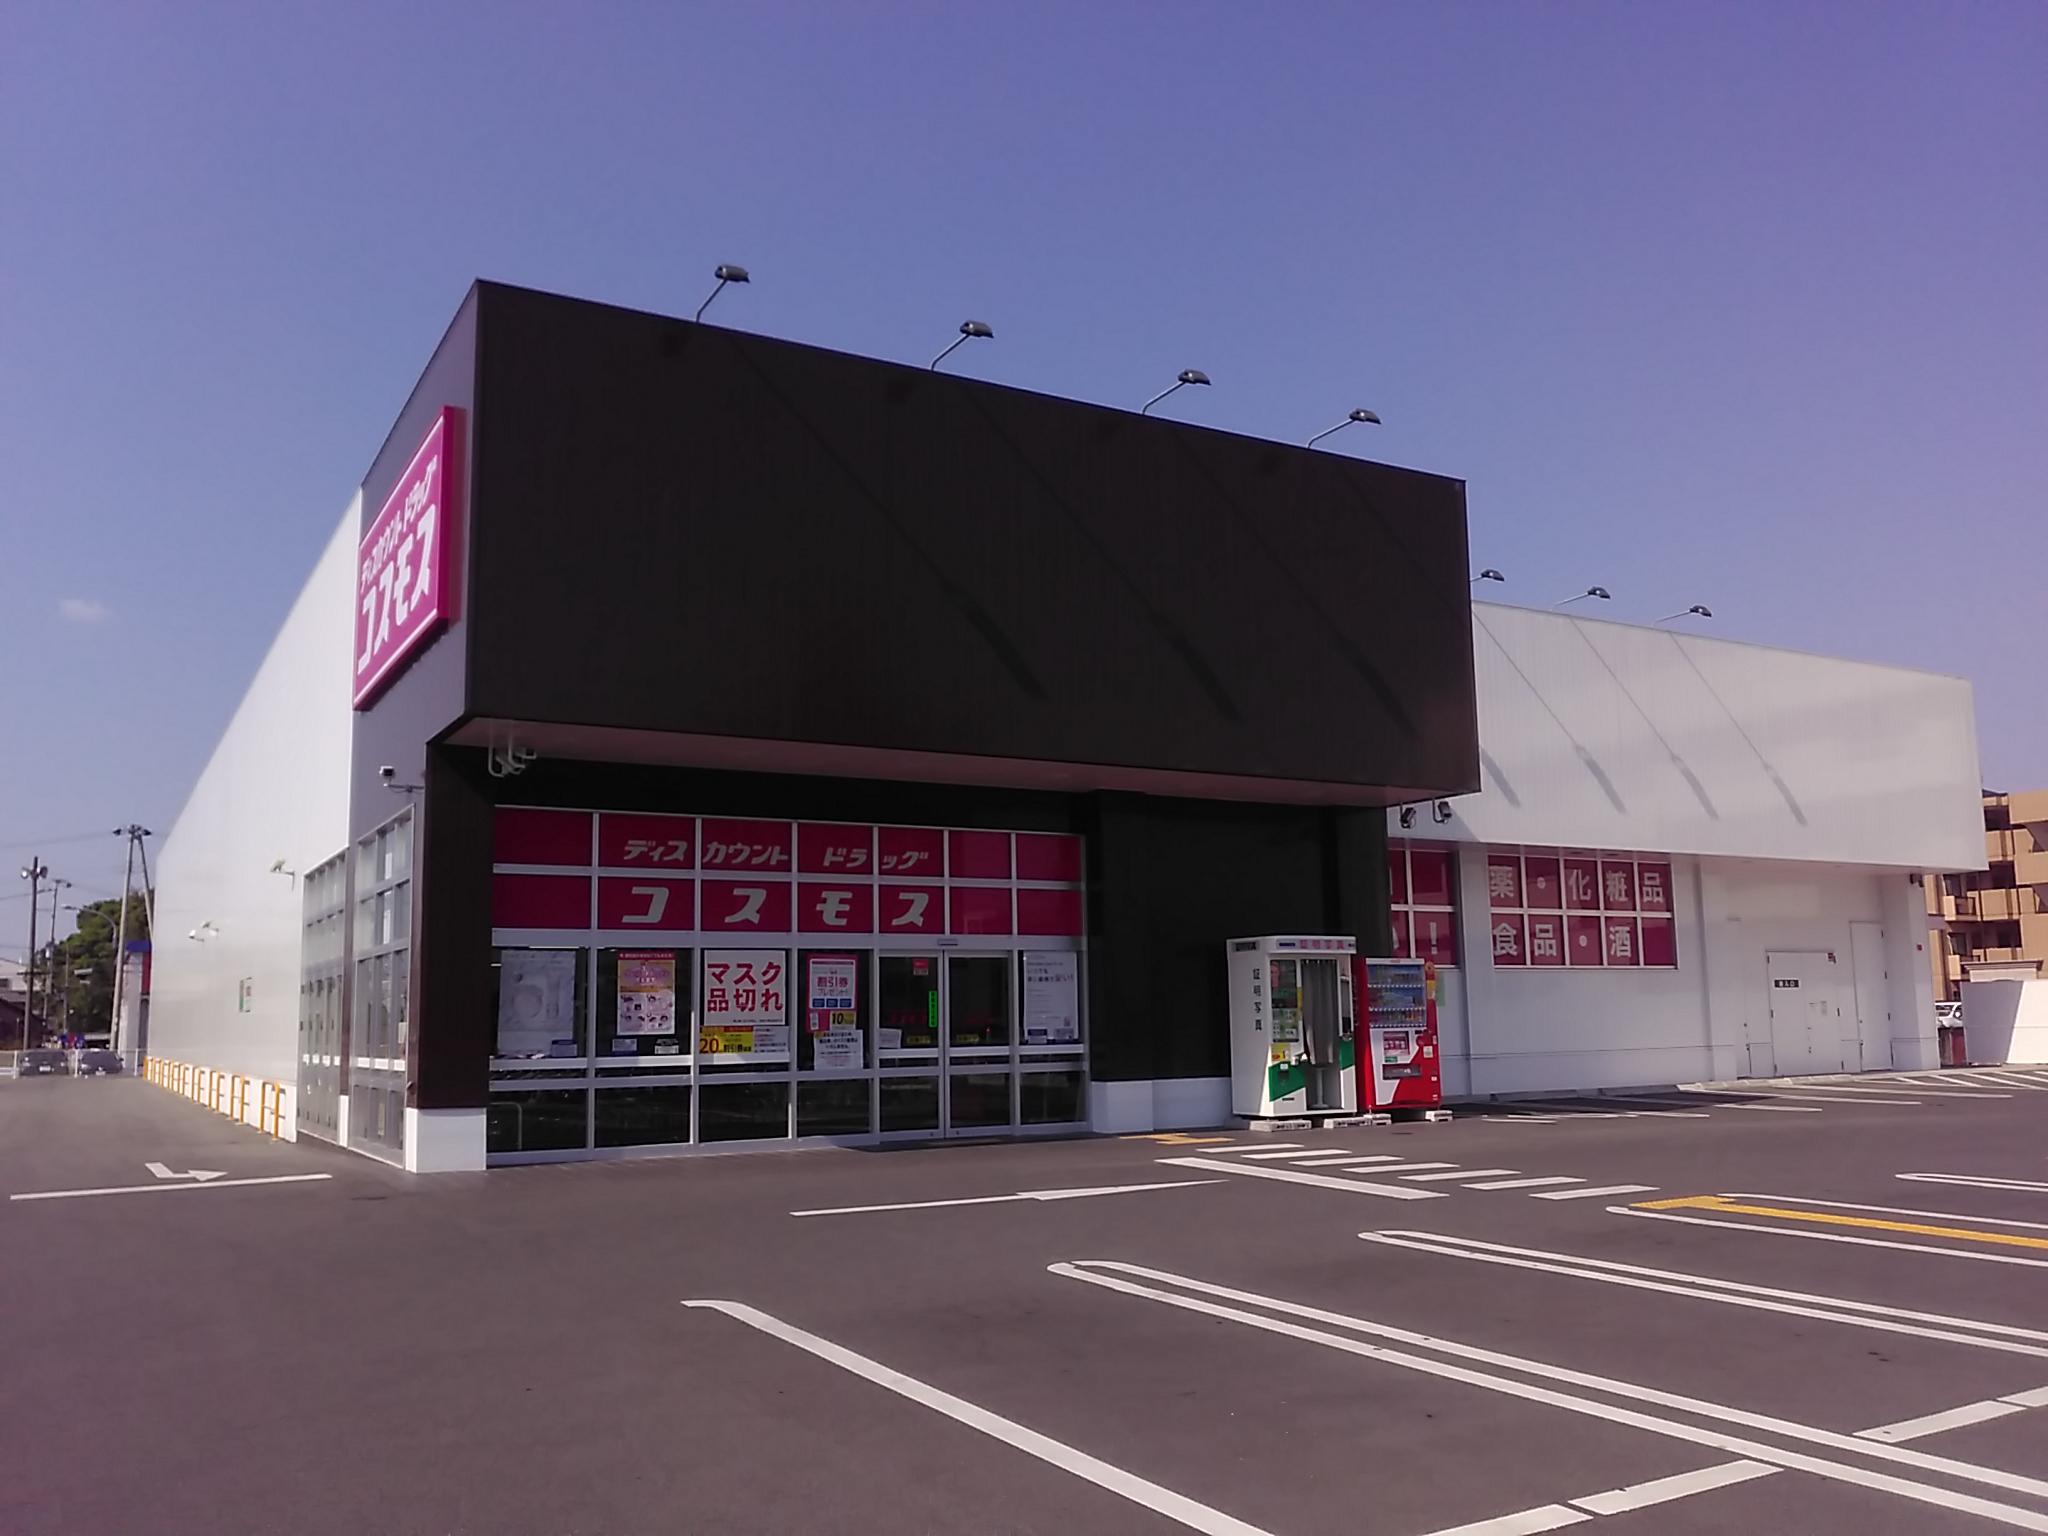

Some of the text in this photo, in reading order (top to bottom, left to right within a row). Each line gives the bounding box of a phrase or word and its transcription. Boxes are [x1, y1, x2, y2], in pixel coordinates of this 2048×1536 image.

[357, 503, 437, 675] コスモス
[623, 839, 929, 870] ディスカウント ドラッグ
[621, 886, 929, 928] コスモス
[707, 961, 783, 985] マスク
[707, 988, 783, 1012] 品切れ
